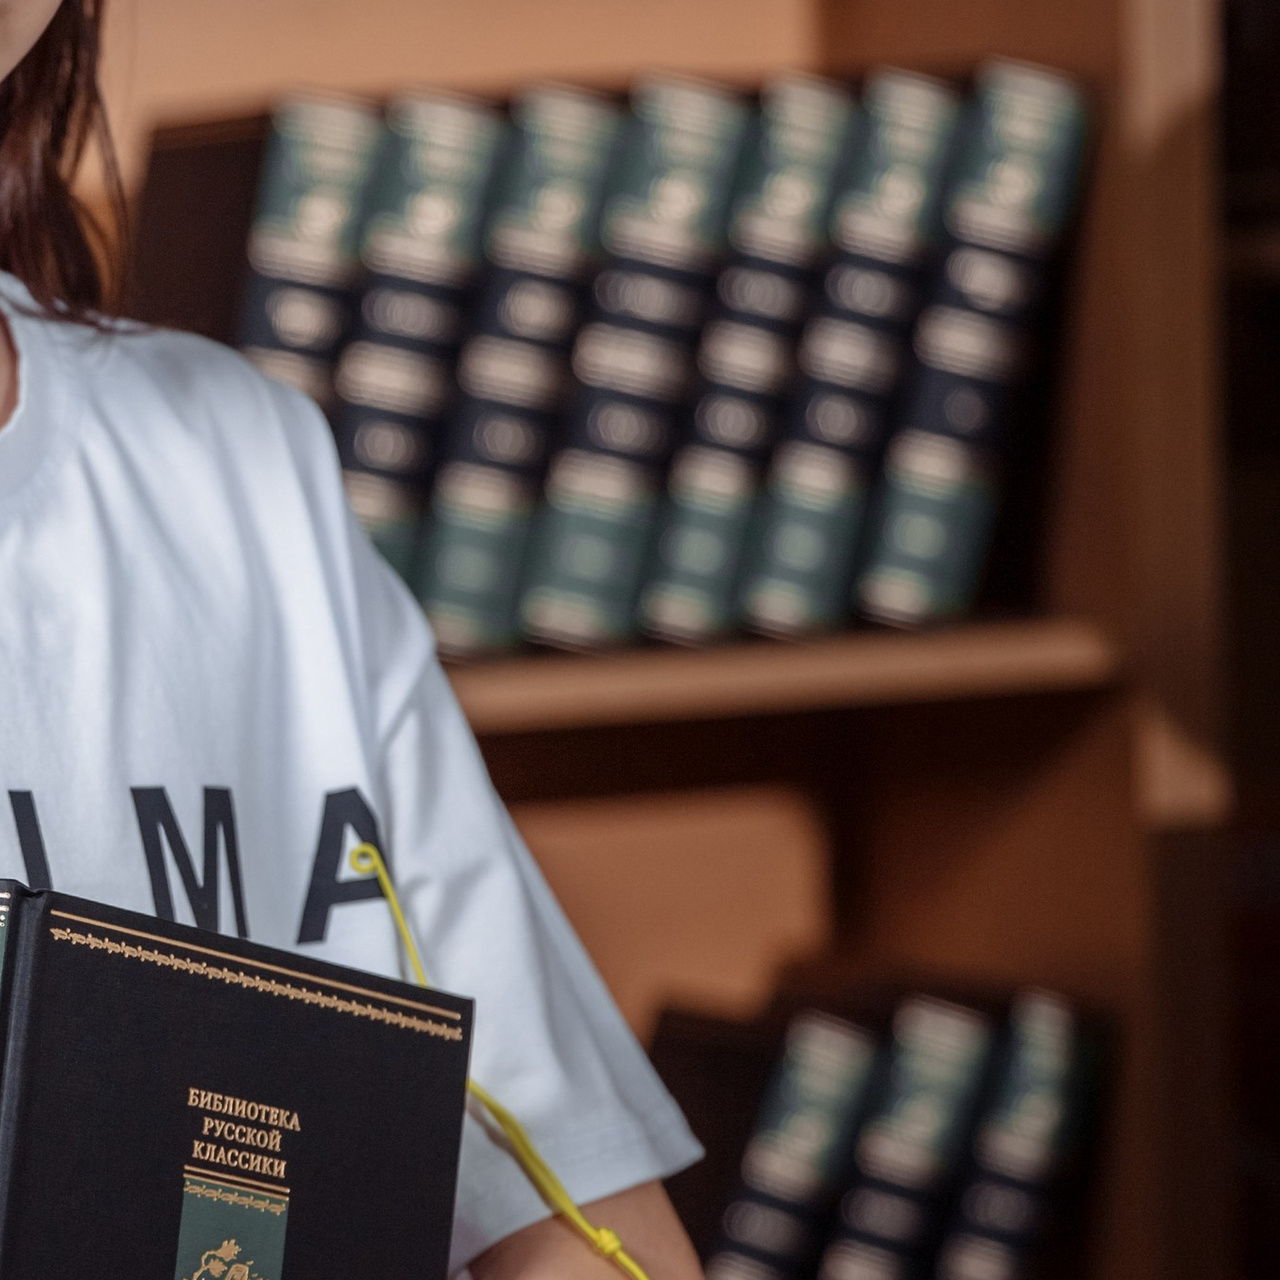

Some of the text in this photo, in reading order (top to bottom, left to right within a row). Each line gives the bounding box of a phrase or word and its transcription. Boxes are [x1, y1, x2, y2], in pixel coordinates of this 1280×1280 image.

[187, 1087, 301, 1132] БИБЛИОТЕКА
[202, 1117, 282, 1152] РУССКОЙ
[192, 1140, 287, 1178] КЛАССИКИ
